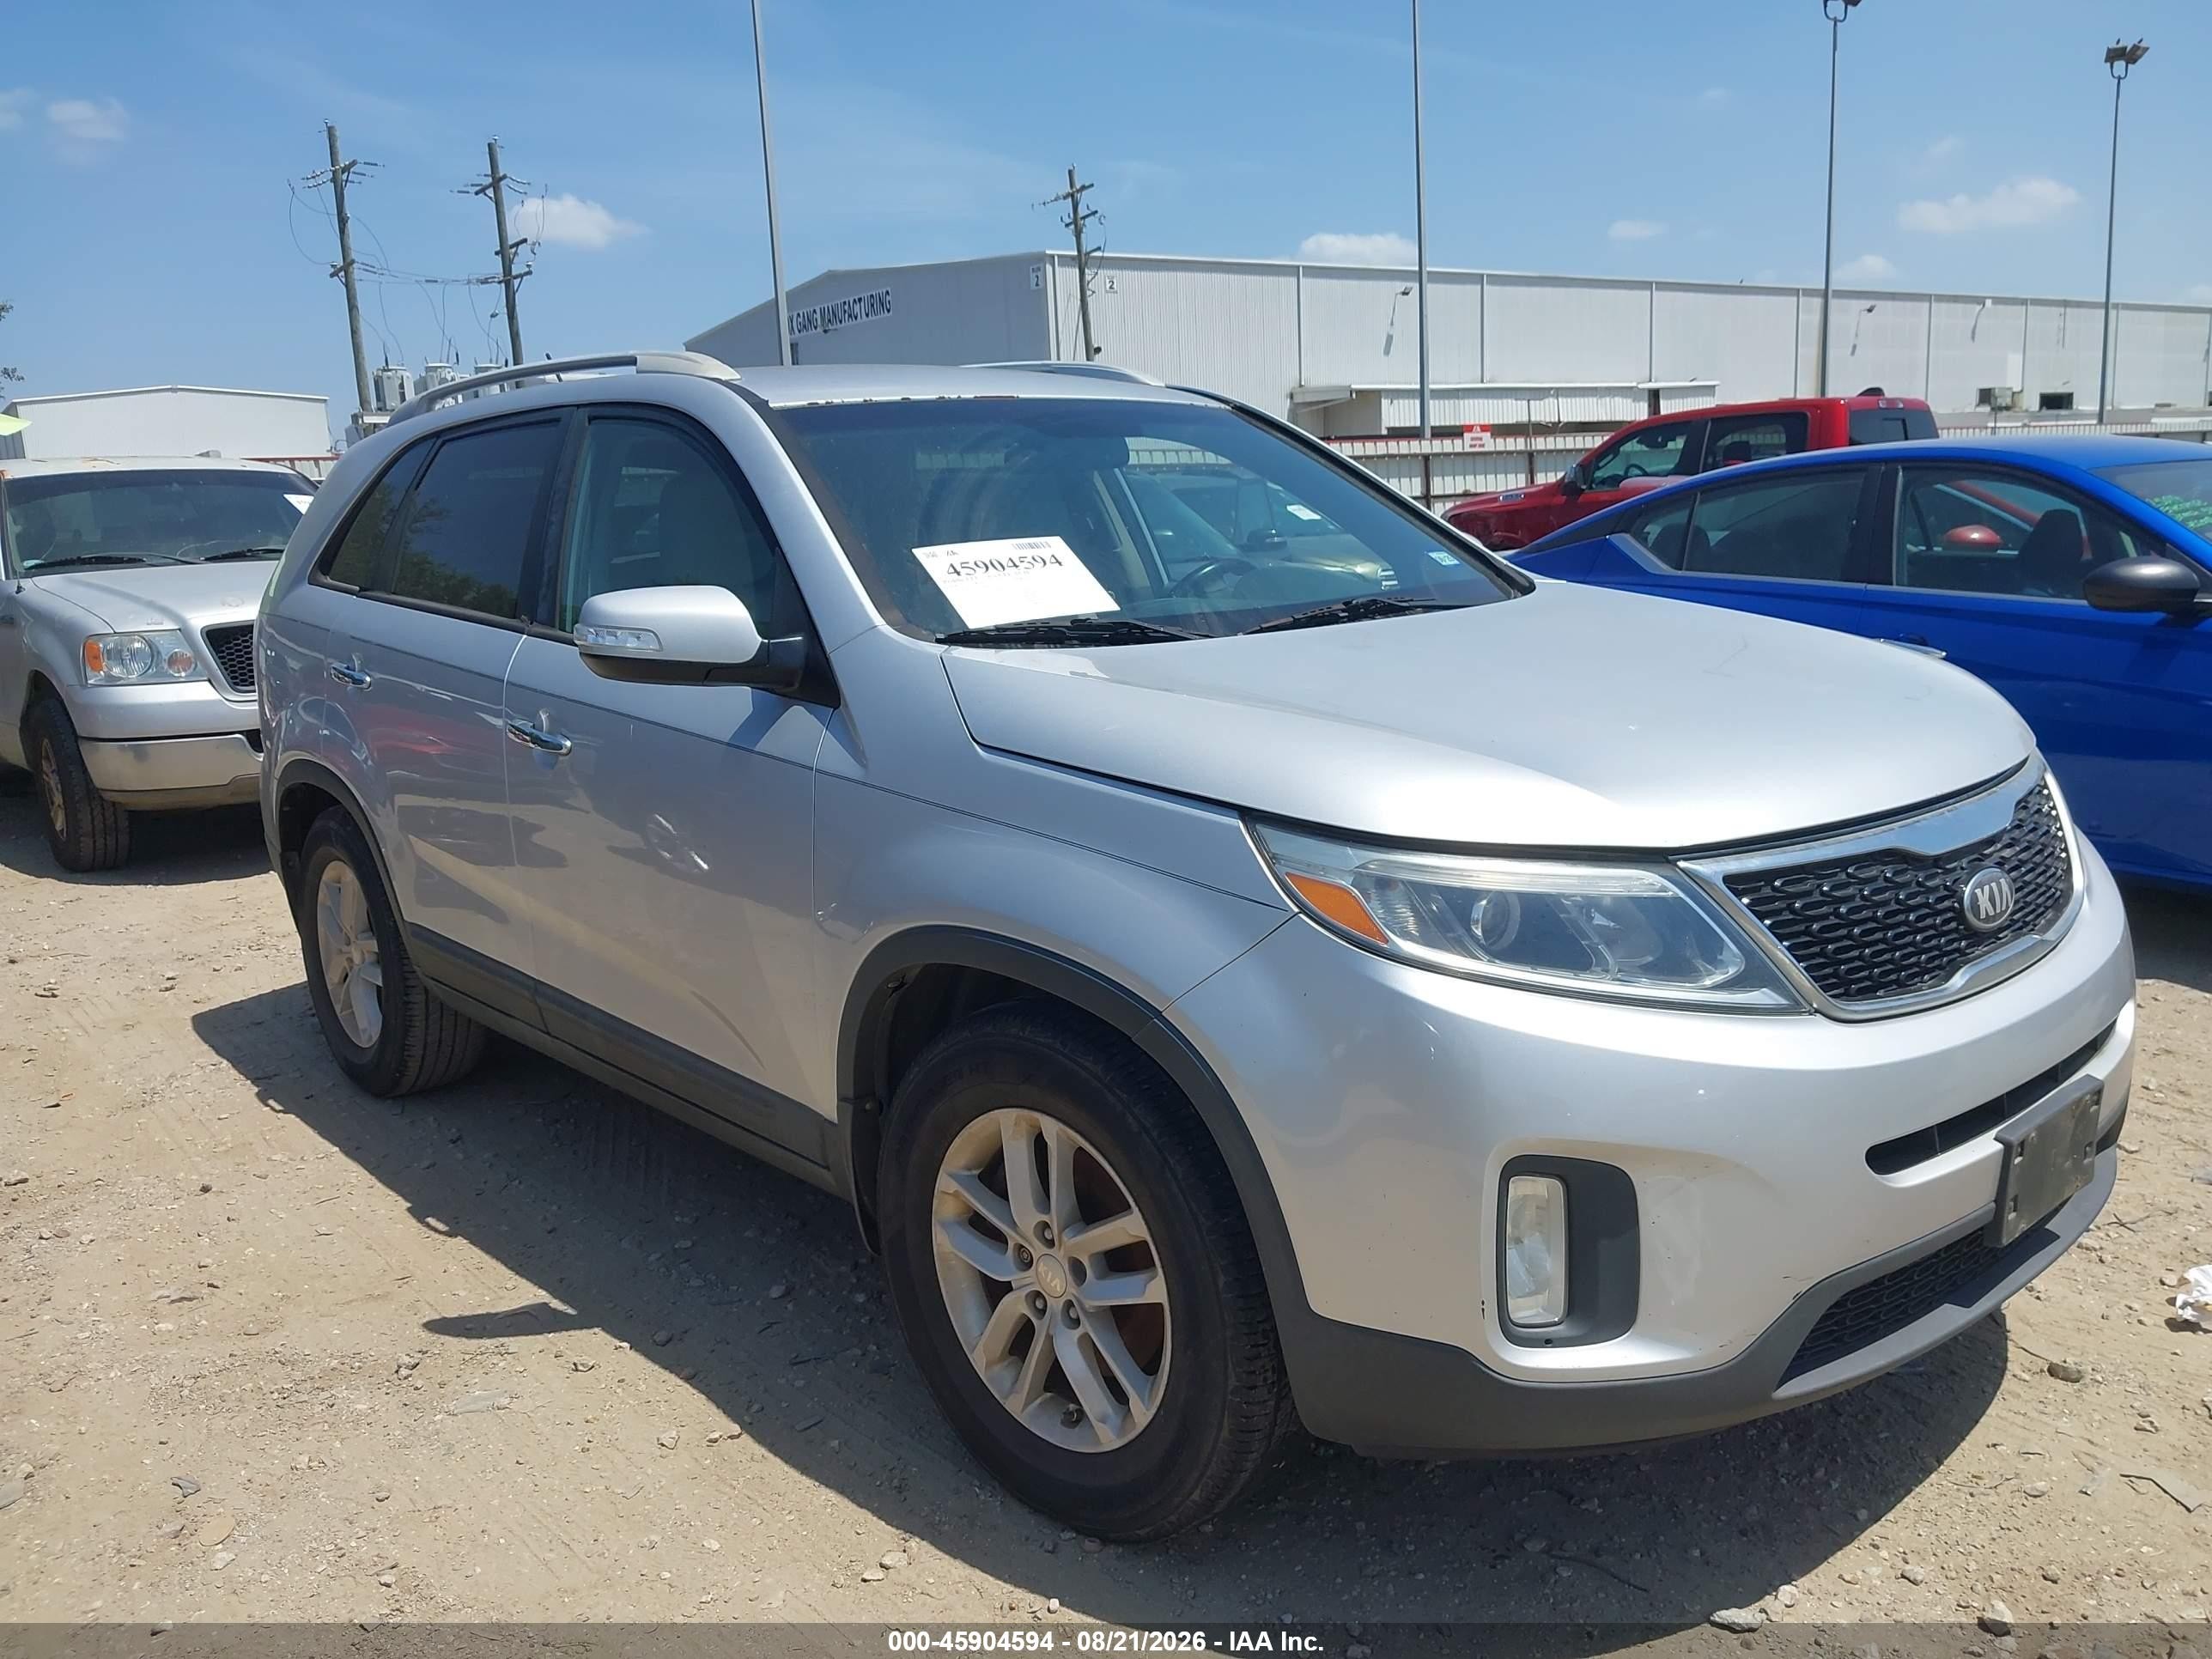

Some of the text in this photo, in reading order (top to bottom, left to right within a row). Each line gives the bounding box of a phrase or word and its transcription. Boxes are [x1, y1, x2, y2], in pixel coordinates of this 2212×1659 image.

[1035, 274, 1040, 287] 2
[1108, 280, 1115, 290] 2
[796, 309, 818, 334] GANG
[819, 290, 892, 330] MANUFACTURING
[947, 554, 1063, 576] 45904594
[1974, 878, 2012, 920] KIA
[1039, 1262, 1060, 1291] KIA
